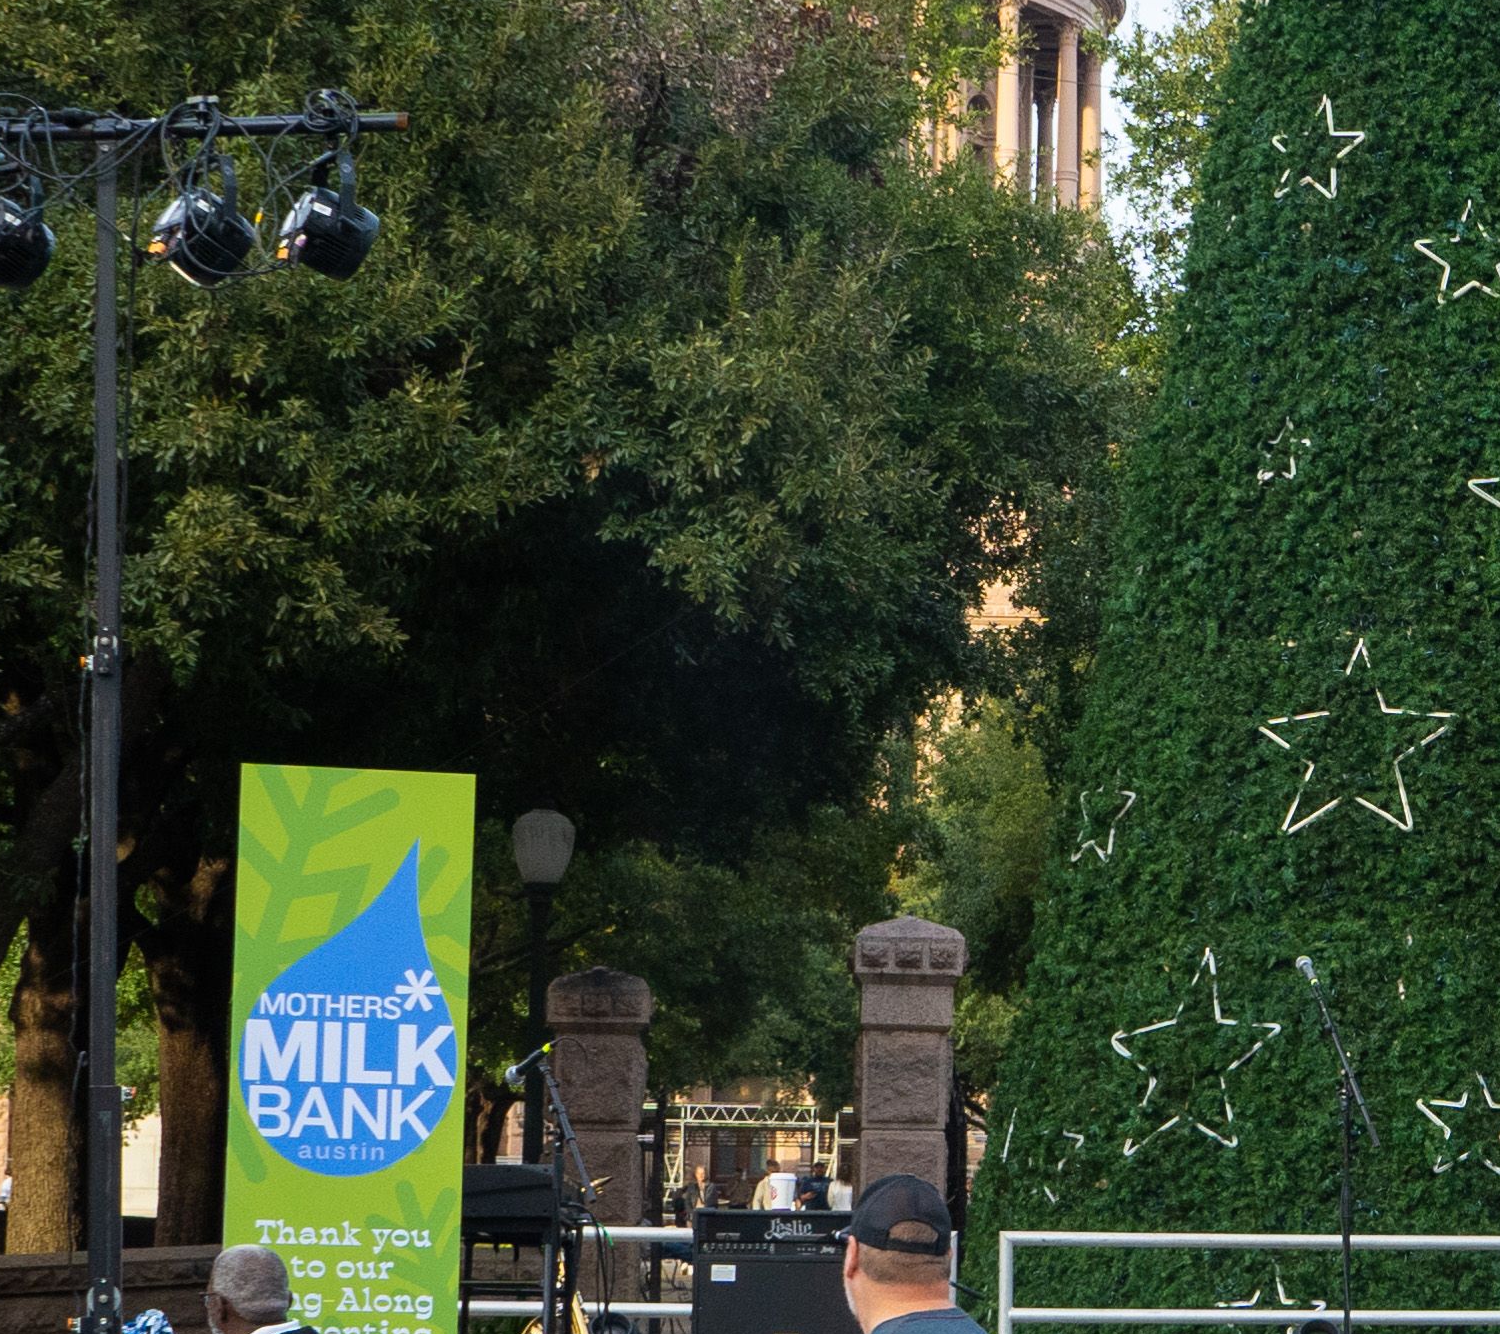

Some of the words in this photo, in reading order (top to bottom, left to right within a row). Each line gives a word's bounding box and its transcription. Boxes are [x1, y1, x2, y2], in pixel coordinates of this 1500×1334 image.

[259, 992, 401, 1020] MOTHERS
[244, 1019, 458, 1087] MILK
[249, 1084, 437, 1141] BANK
[298, 1140, 386, 1161] austin
[255, 1219, 362, 1246] Thank
[371, 1229, 432, 1254] you
[764, 1219, 813, 1239] Leslie
[290, 1256, 326, 1278] to
[336, 1260, 394, 1279] our
[290, 1287, 434, 1320] ng-Along
